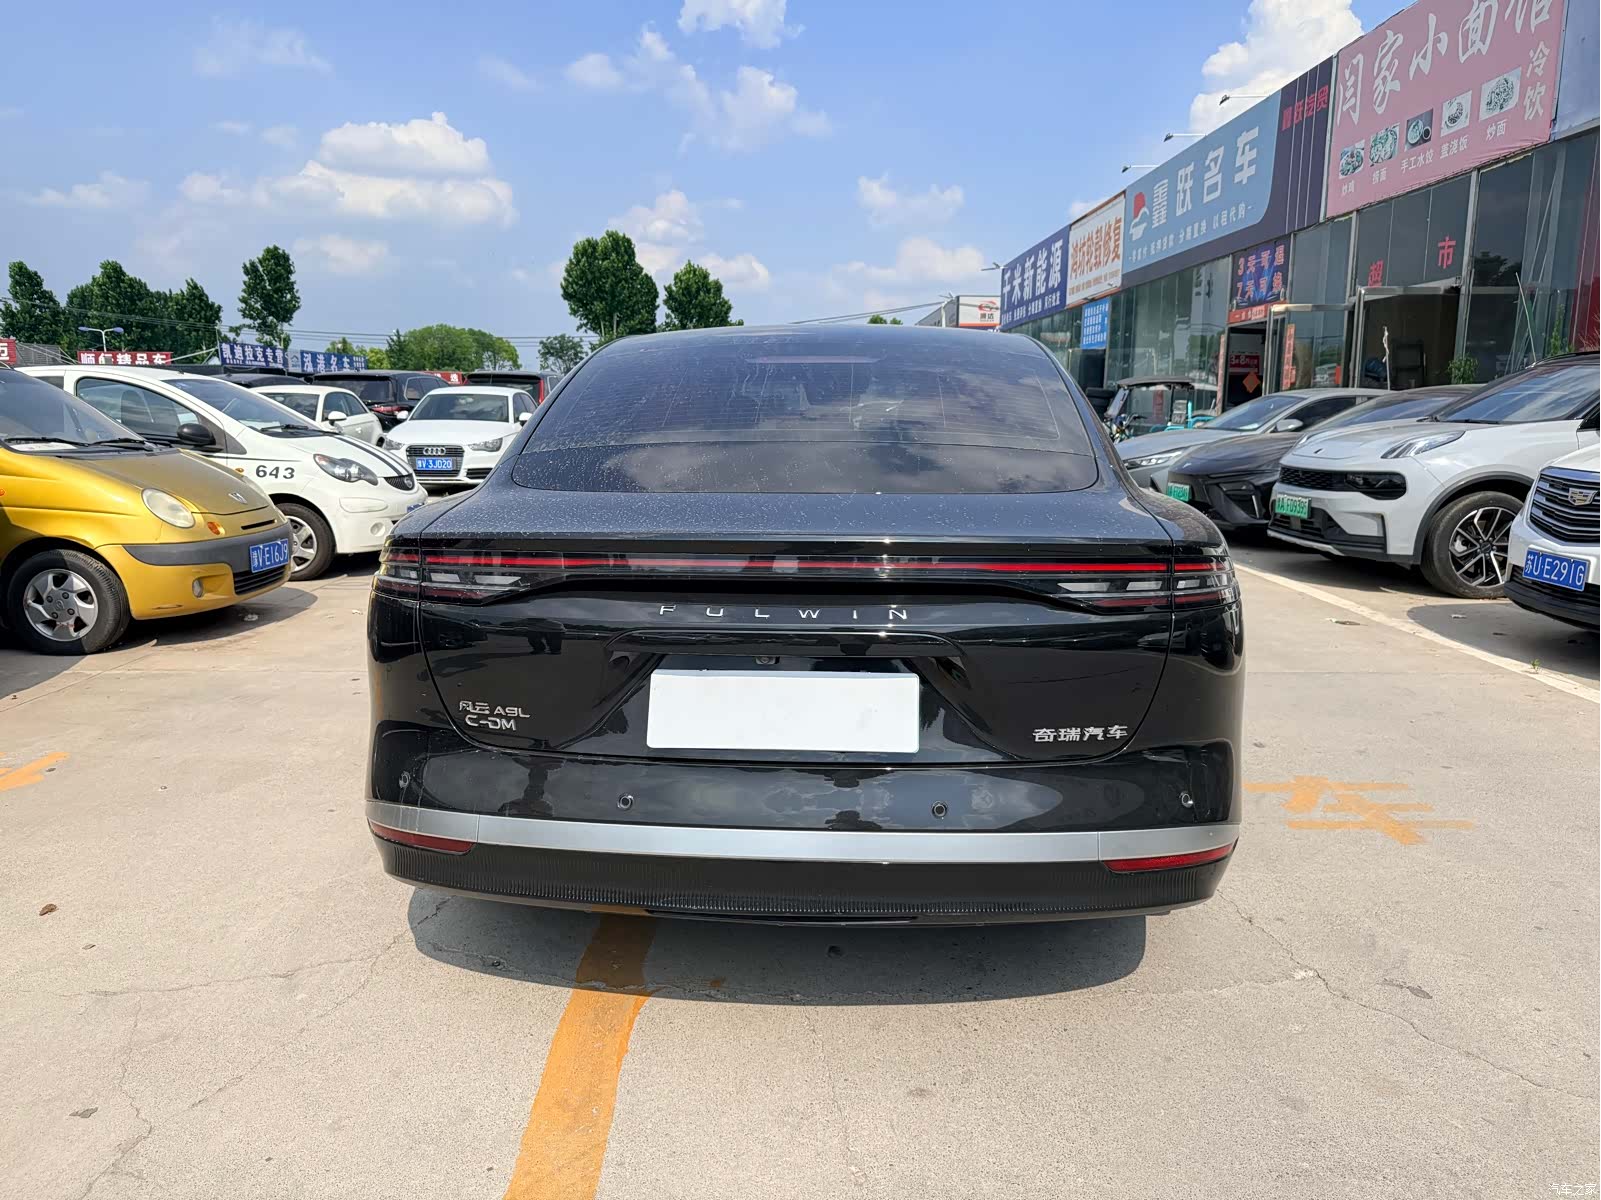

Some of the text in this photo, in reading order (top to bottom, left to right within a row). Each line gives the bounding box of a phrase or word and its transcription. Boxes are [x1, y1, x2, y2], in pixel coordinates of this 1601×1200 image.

[1523, 40, 1551, 121] 冷饮
[1486, 119, 1508, 141] 炒面
[1439, 135, 1469, 159] 盖浇饭
[1400, 149, 1434, 174] 手工水饺
[1151, 126, 1260, 229] 鑫跃名车
[256, 465, 295, 479] 643
[659, 604, 908, 620] FULWIN
[459, 700, 531, 718] 风云 A9L
[465, 714, 517, 731] C-DM
[1032, 724, 1128, 742] 奇瑞汽车
